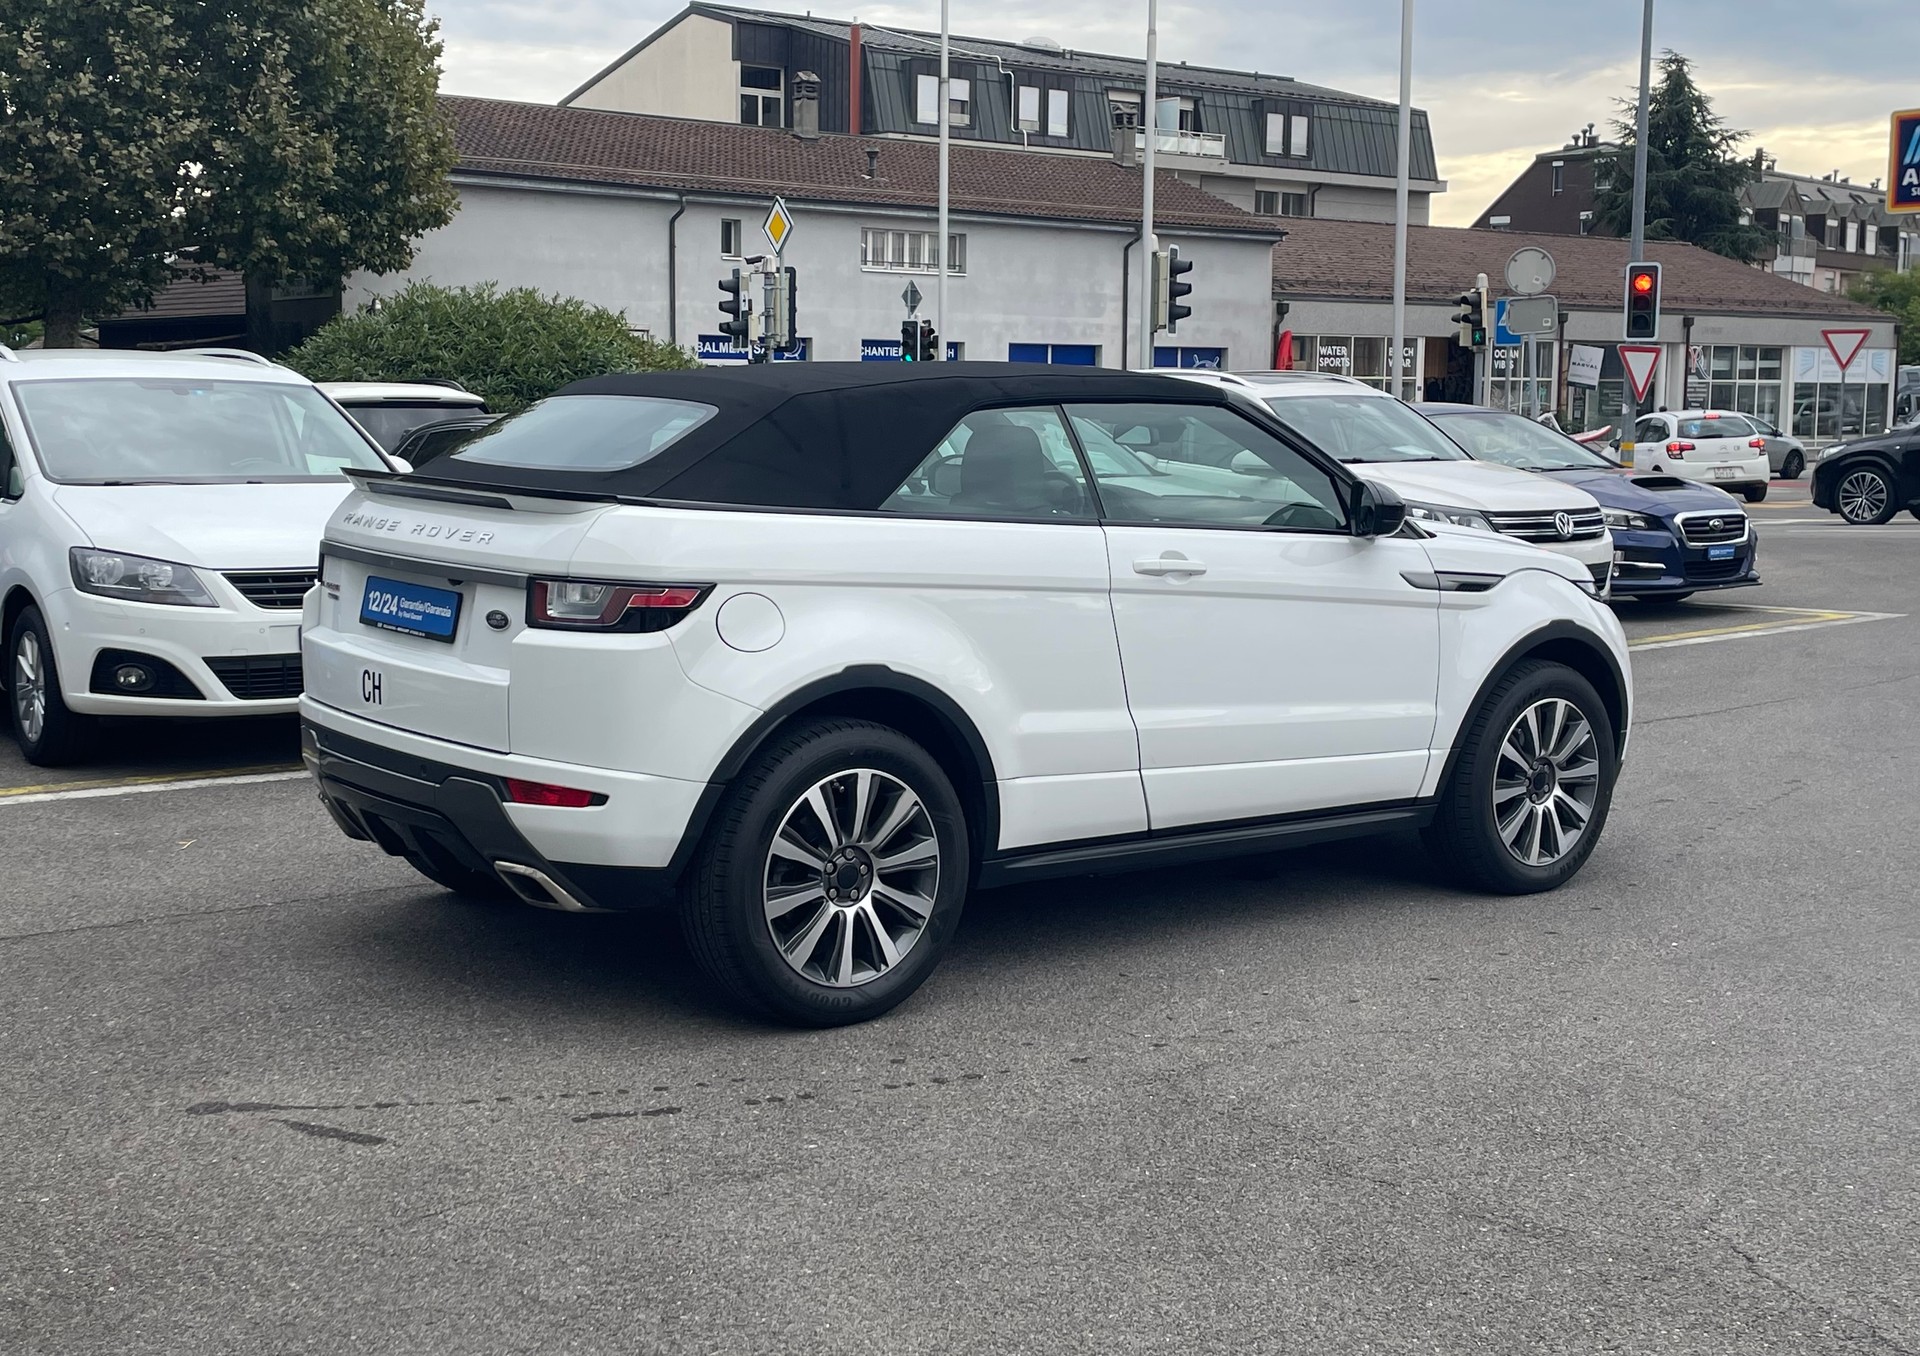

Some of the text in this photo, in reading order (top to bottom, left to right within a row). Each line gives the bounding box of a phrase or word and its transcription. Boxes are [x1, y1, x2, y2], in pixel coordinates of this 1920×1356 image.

[697, 341, 746, 354] BALME
[1319, 345, 1347, 356] WATER
[1494, 349, 1519, 359] OCAN
[1319, 357, 1350, 367] SPORTS
[1494, 359, 1514, 370] VIBS
[1571, 361, 1598, 370] MARVAL
[343, 513, 495, 545] RANGE ROVER
[368, 590, 398, 616] 12/24
[362, 669, 382, 705] CH
